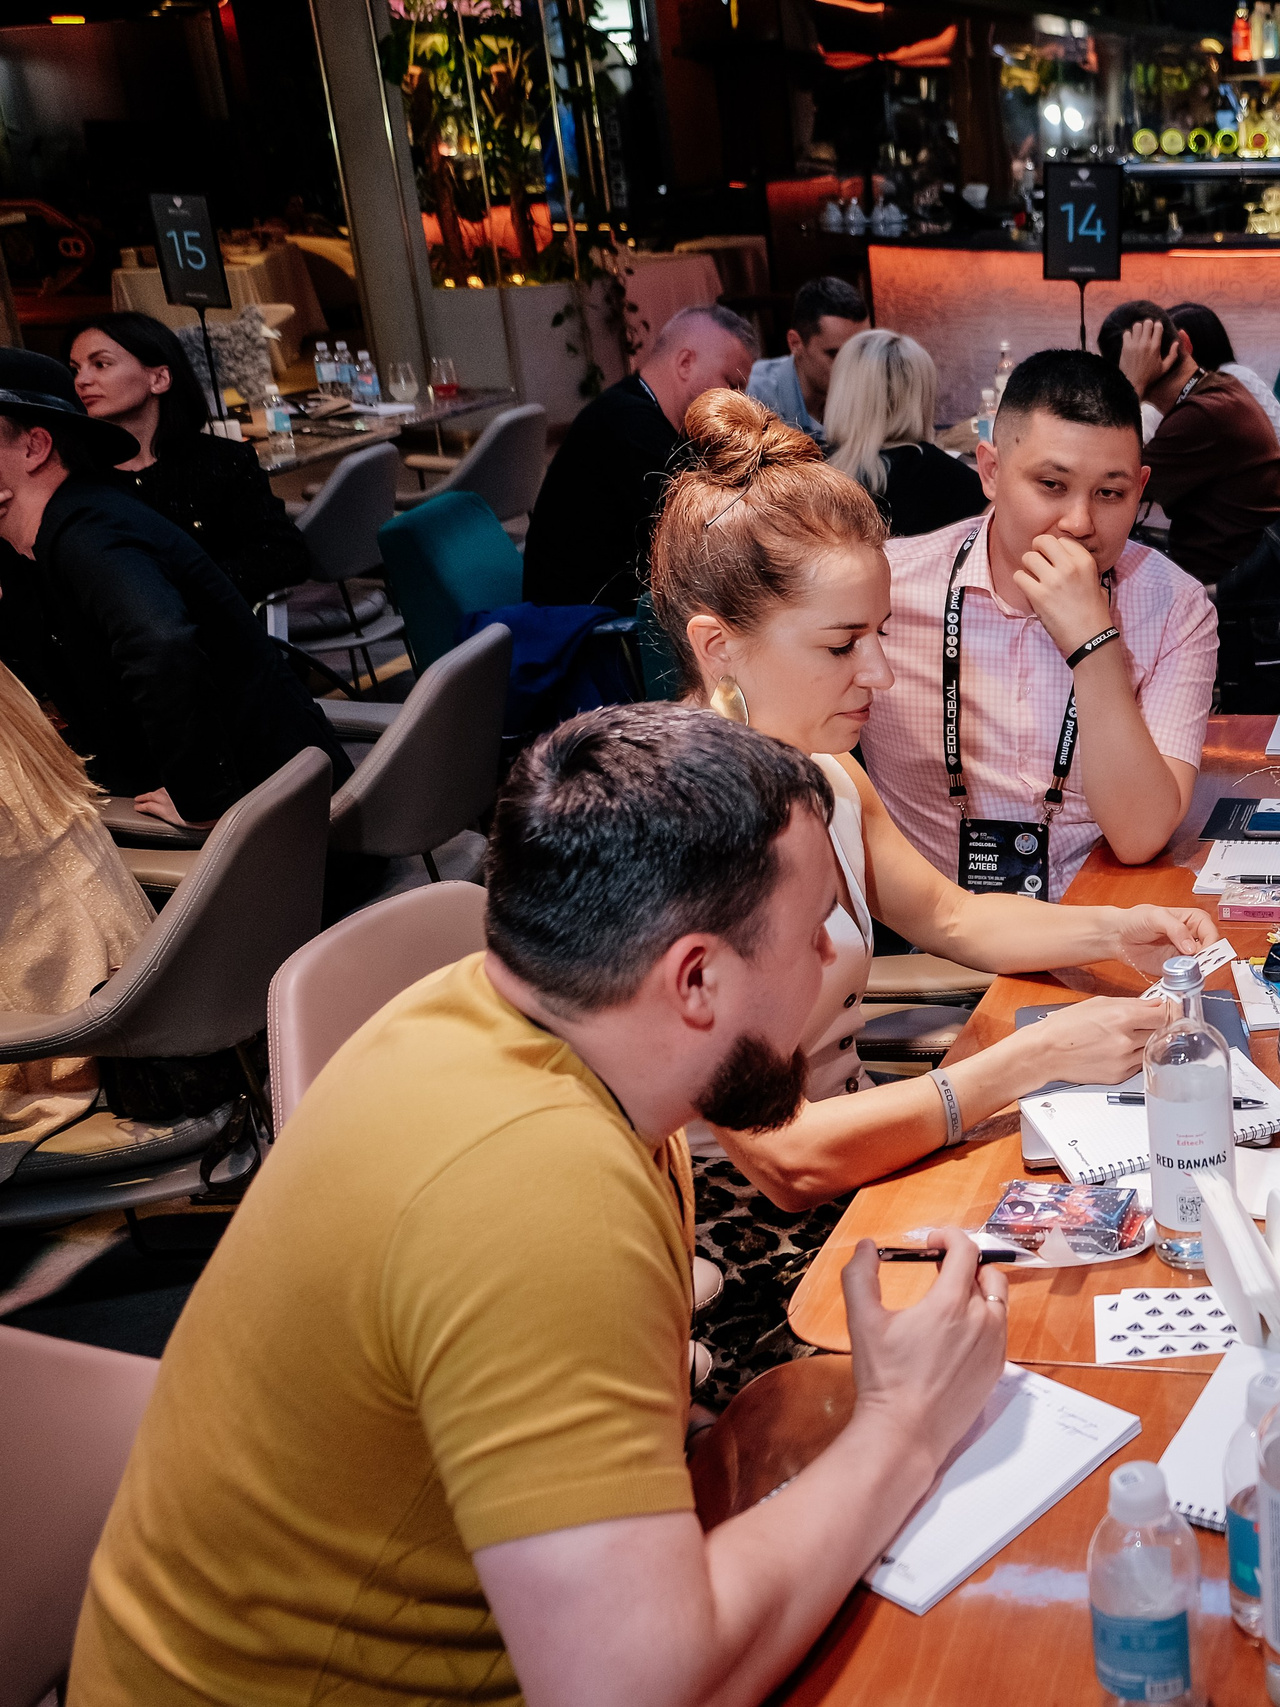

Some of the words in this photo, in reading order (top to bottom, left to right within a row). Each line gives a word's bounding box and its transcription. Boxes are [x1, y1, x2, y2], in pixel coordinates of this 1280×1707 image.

[1060, 203, 1107, 243] 14
[166, 230, 207, 270] 15
[946, 680, 957, 754] EDGLOBAL
[1059, 720, 1075, 766] prodamus
[968, 853, 999, 863] РИНАТ
[968, 862, 998, 871] АЛЕЕВ
[1156, 1153, 1174, 1169] RED
[1177, 1150, 1227, 1170] BANANAS
